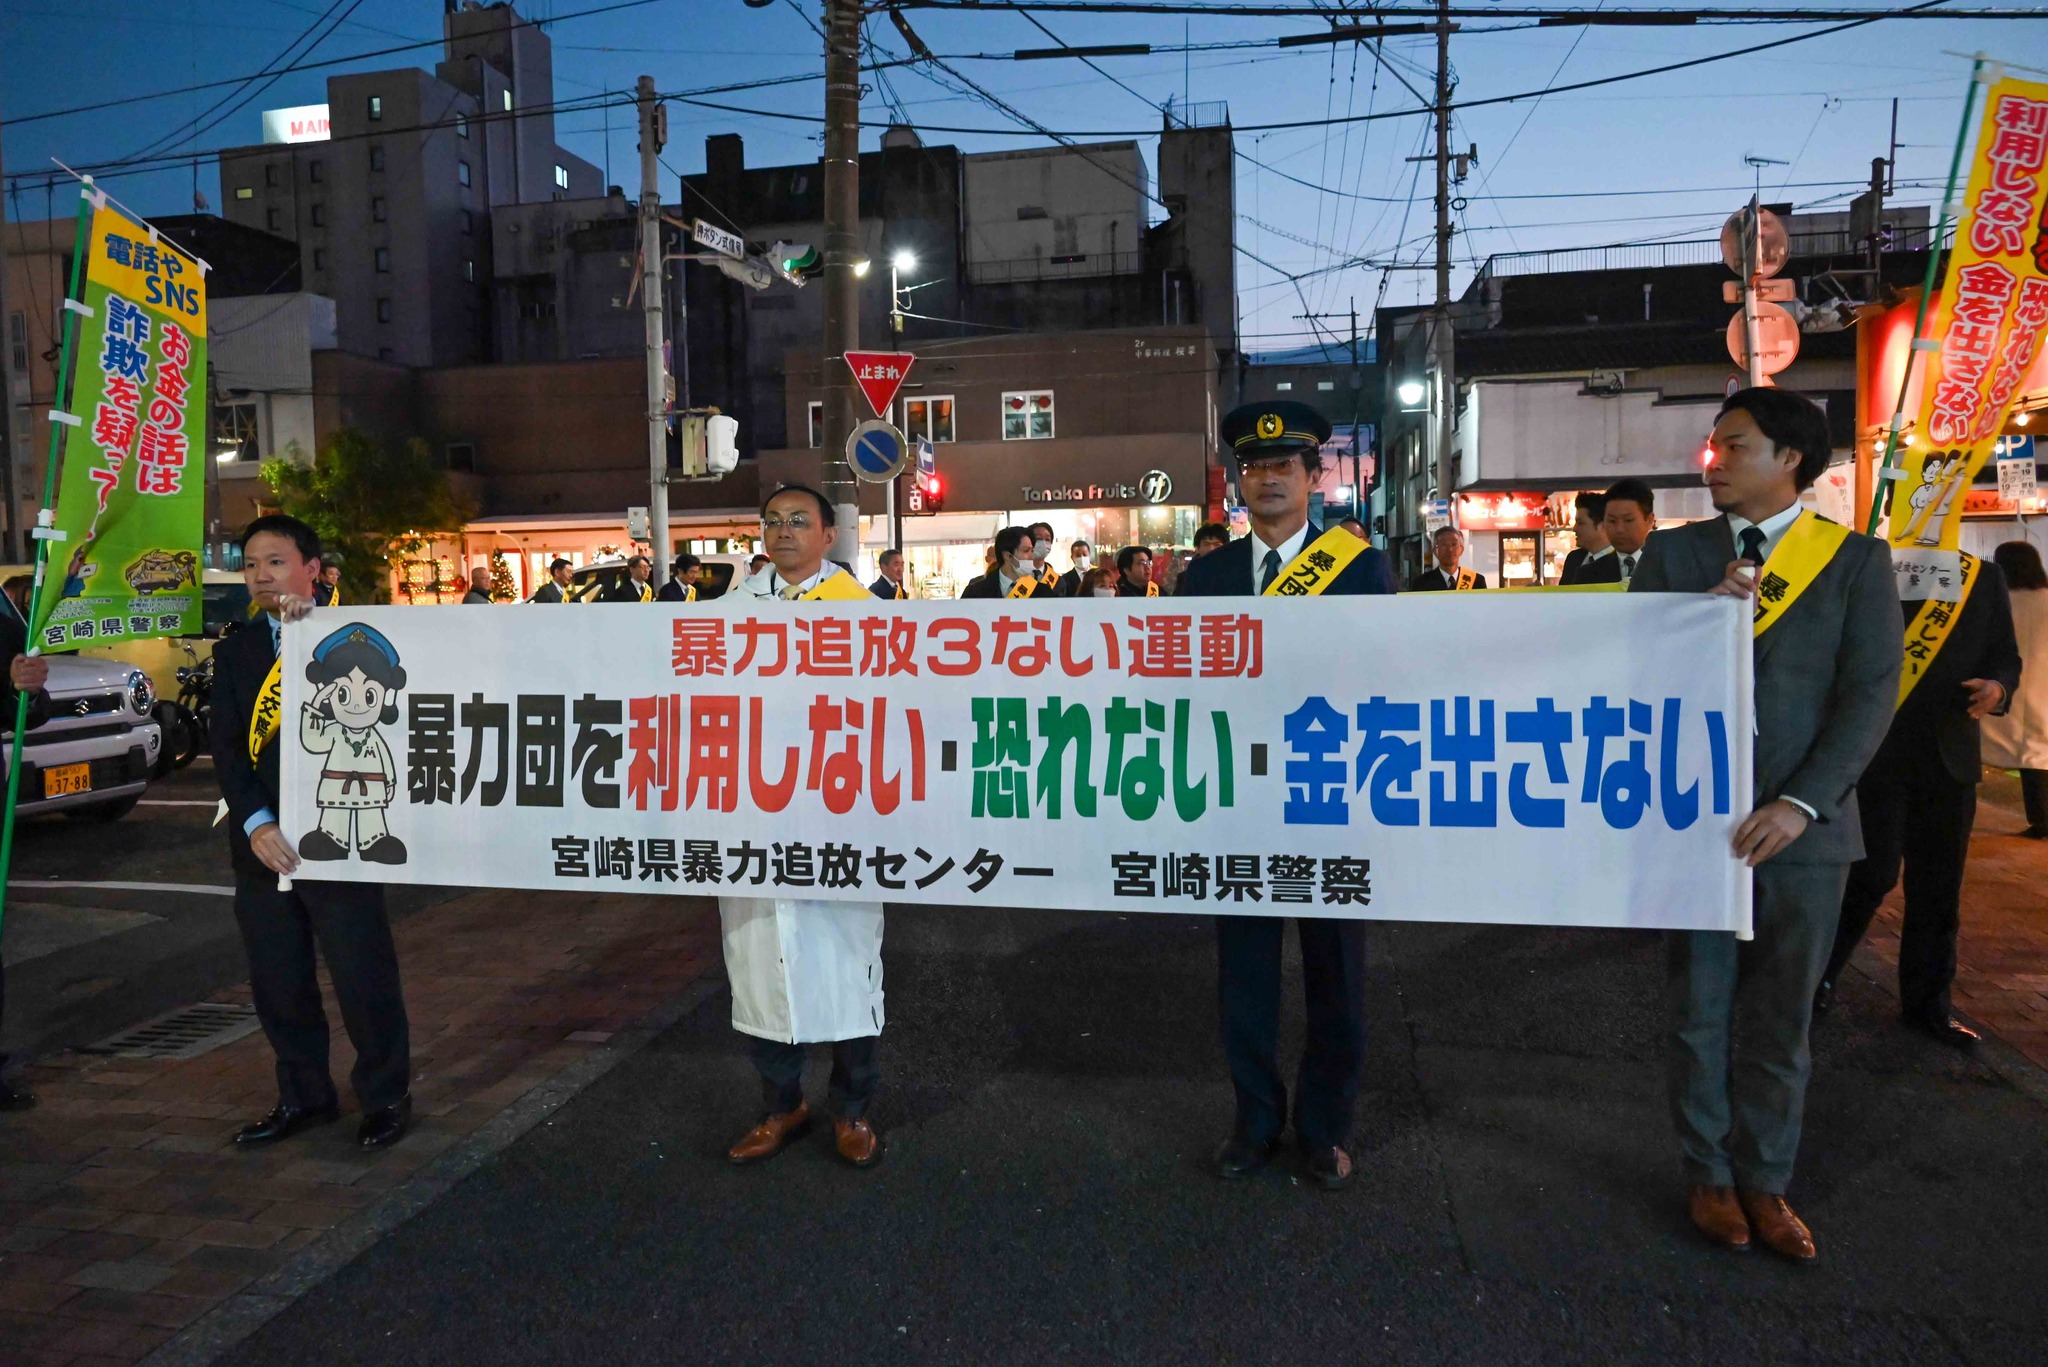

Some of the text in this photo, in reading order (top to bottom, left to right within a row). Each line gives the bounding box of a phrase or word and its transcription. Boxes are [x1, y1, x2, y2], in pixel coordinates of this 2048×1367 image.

[1973, 98, 2048, 250] 利用しない
[105, 233, 183, 278] 電話や
[145, 275, 200, 316] SNS
[859, 364, 900, 380] 止まれ
[1931, 263, 2014, 440] 金を出さない
[87, 297, 149, 538] 詐欺を疑って
[137, 324, 190, 494] お金の話は
[2006, 435, 2027, 457] P
[1022, 483, 1136, 502] Tanaka Fruits
[1276, 549, 1336, 596] 暴力団
[45, 614, 181, 646] 宮崎県警察
[672, 614, 1263, 678] 暴力追放3ない運動
[252, 667, 281, 757] と交際し
[407, 692, 1730, 831] 暴力団を利用しない・恐れない・金を出さない
[551, 835, 1372, 906] 宮崎県暴力追放センター 宮崎県警察
